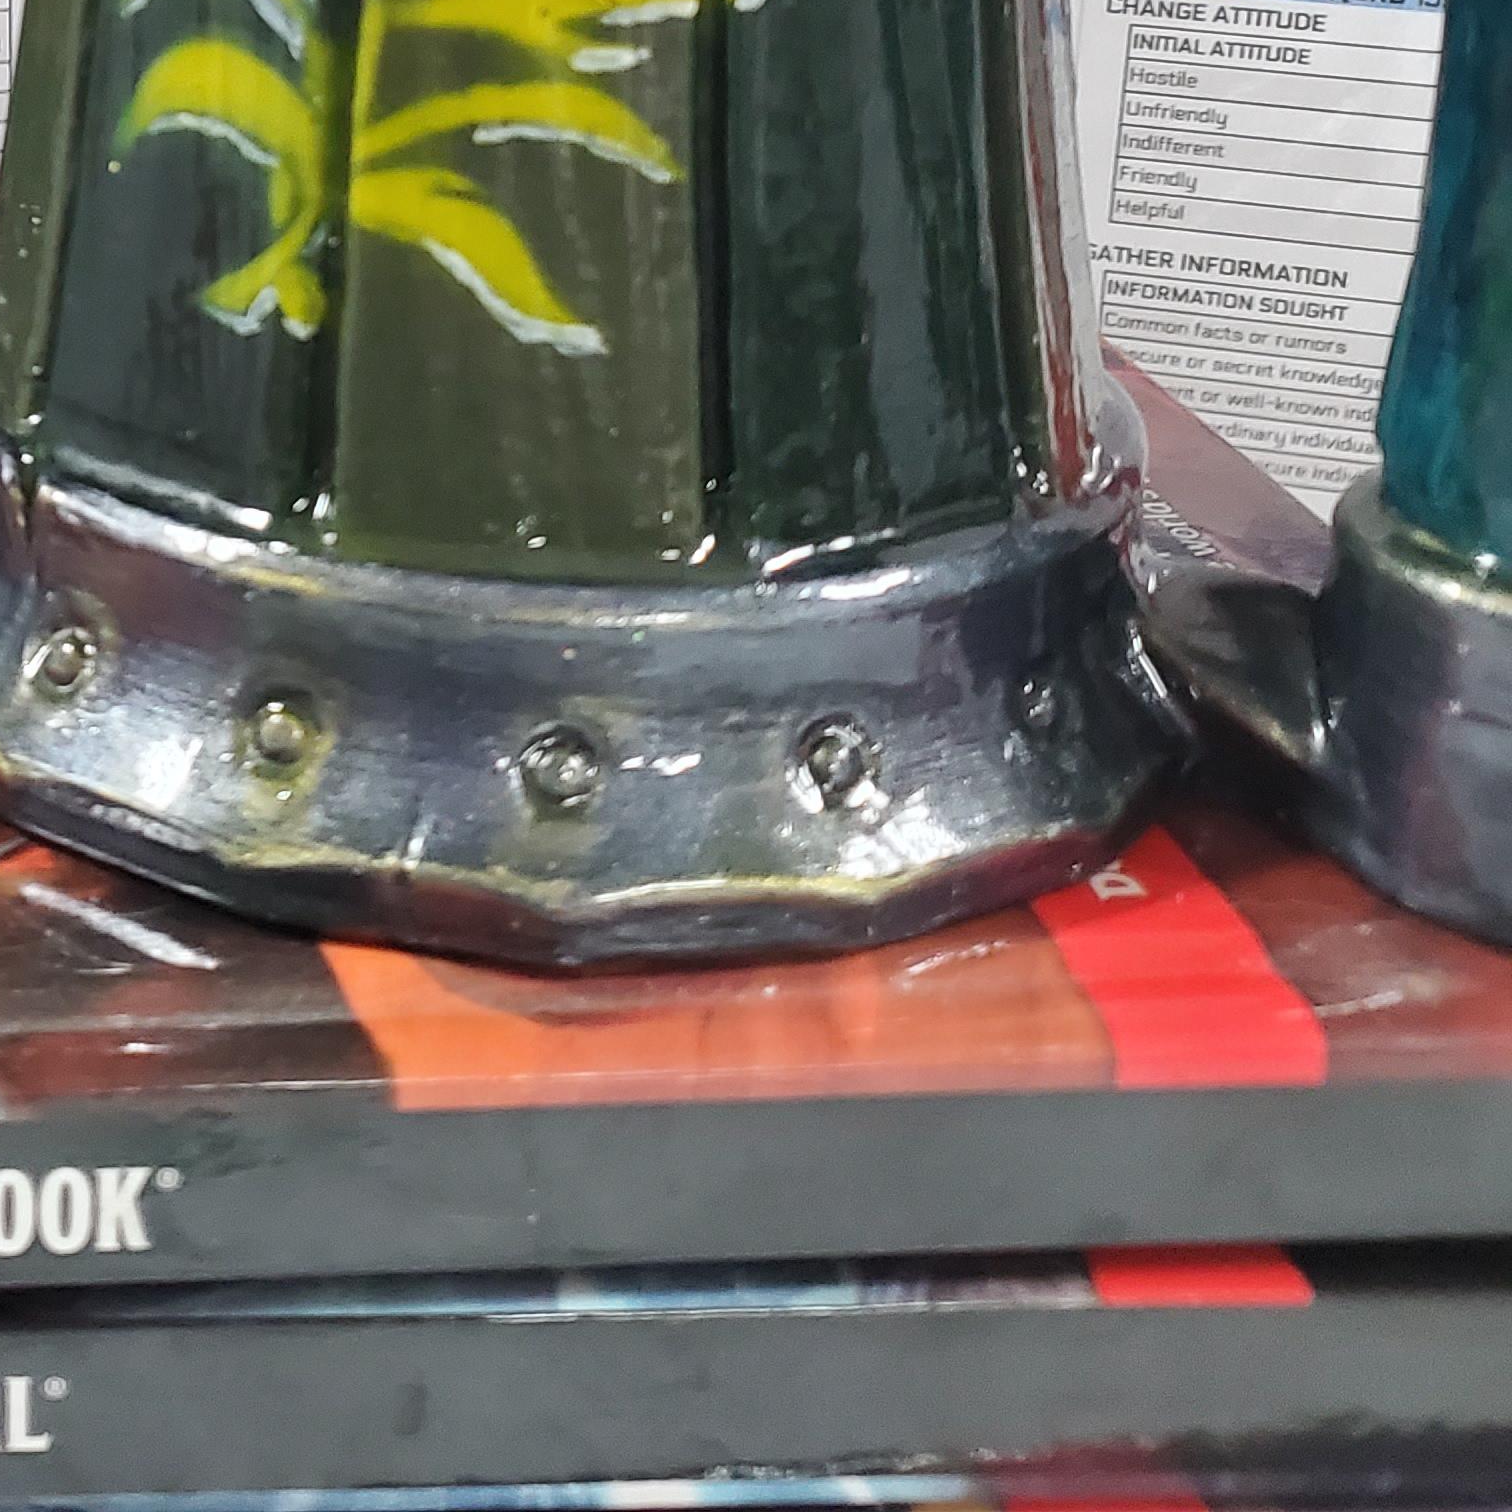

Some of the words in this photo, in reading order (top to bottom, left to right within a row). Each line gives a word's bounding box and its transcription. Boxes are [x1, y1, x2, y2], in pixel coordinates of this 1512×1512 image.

[1212, 5, 1327, 33] ATTITUDE
[1133, 33, 1205, 56] INITIAL
[1210, 41, 1311, 66] ATTITUDE
[1129, 68, 1198, 88] Hostile
[1126, 100, 1228, 128] Unfriendly
[1123, 133, 1224, 158] Indifferent
[1181, 253, 1348, 288] INFORMATION
[1105, 276, 1253, 311] INFORMATION
[1259, 297, 1349, 321] SOUGHT
